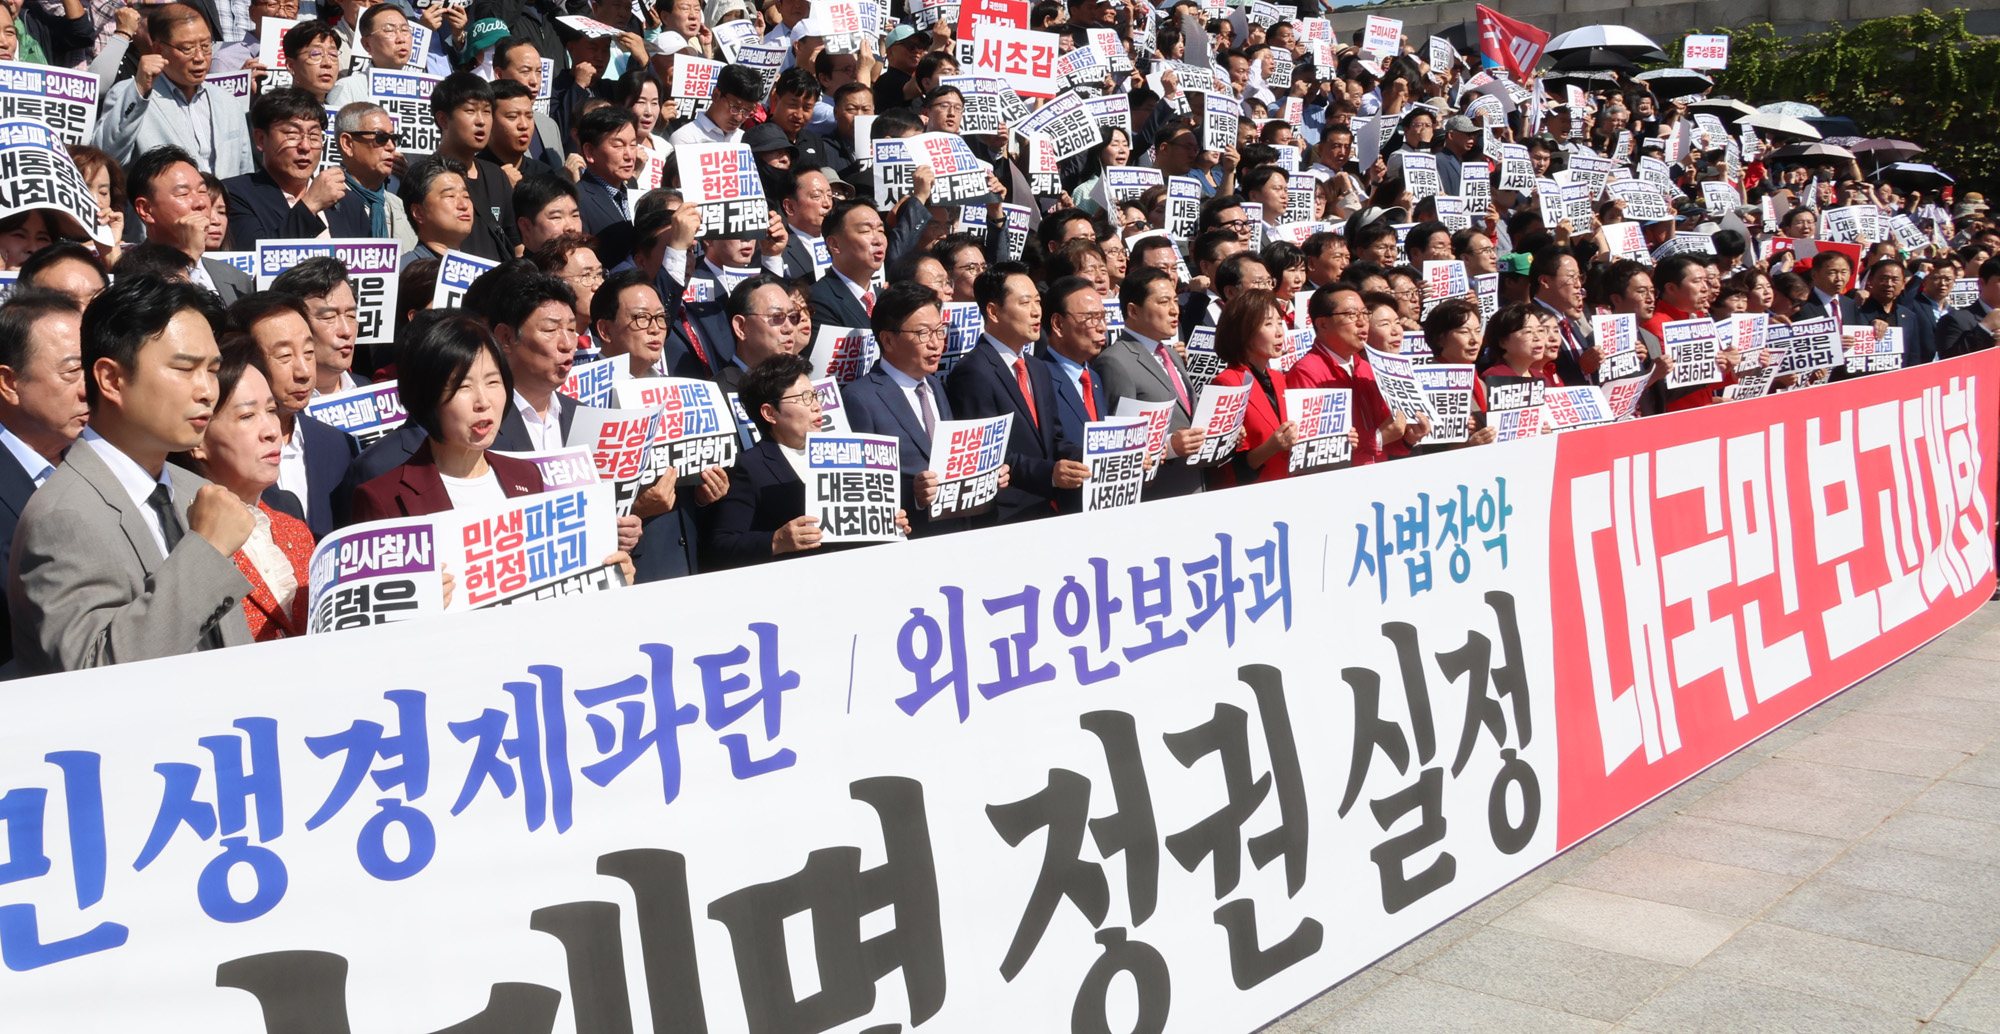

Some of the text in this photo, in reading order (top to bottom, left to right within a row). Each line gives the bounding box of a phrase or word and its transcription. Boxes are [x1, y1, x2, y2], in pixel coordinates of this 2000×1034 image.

[1369, 24, 1398, 40] 구미시갑
[977, 38, 1055, 78] 서초갑
[1686, 45, 1725, 60] 중구성동갑
[924, 139, 970, 157] 민생파탄
[931, 152, 980, 172] 헌정파괴
[702, 173, 763, 200] 헌정파괴
[1431, 260, 1463, 282] 민생파탄
[1430, 278, 1466, 299] 헌정파괴
[1601, 316, 1629, 338] 민생파탄
[1767, 323, 1835, 341] 실패·인사참사
[1853, 330, 1893, 343] 민생탄
[1671, 341, 1715, 364] 대통령은
[1853, 342, 1893, 355] 헌정파괴
[1671, 362, 1715, 384] 사죄하라
[1846, 354, 1903, 373] 강력 규탄한다
[641, 384, 711, 411] 민생파탄
[1302, 392, 1347, 418] 민생파탄
[1545, 388, 1594, 410] 민생파탄
[1299, 413, 1346, 440] 헌정파괴
[1553, 404, 1603, 426] 헌정파괴
[950, 416, 1008, 454] 민생파탄
[1088, 425, 1149, 451] 정책실패·인사참사
[671, 434, 739, 480] 규탄한다
[809, 439, 897, 470] 정책실패·인사참사
[945, 443, 1002, 480] 헌정파괴
[1091, 451, 1144, 483] 대통령은
[817, 472, 895, 502] 대통령은
[462, 492, 587, 563] 민생파탄
[819, 505, 897, 537] 사죄하라
[1348, 476, 1513, 603] 사법장악
[464, 531, 587, 606] 헌정파괴
[1571, 376, 1993, 777] 대국민 보고대회
[895, 520, 1293, 723] 외교안보파괴
[0, 621, 801, 971] 민생경제파탄
[986, 664, 1324, 1034] 정권
[1339, 591, 1541, 914] 실정
